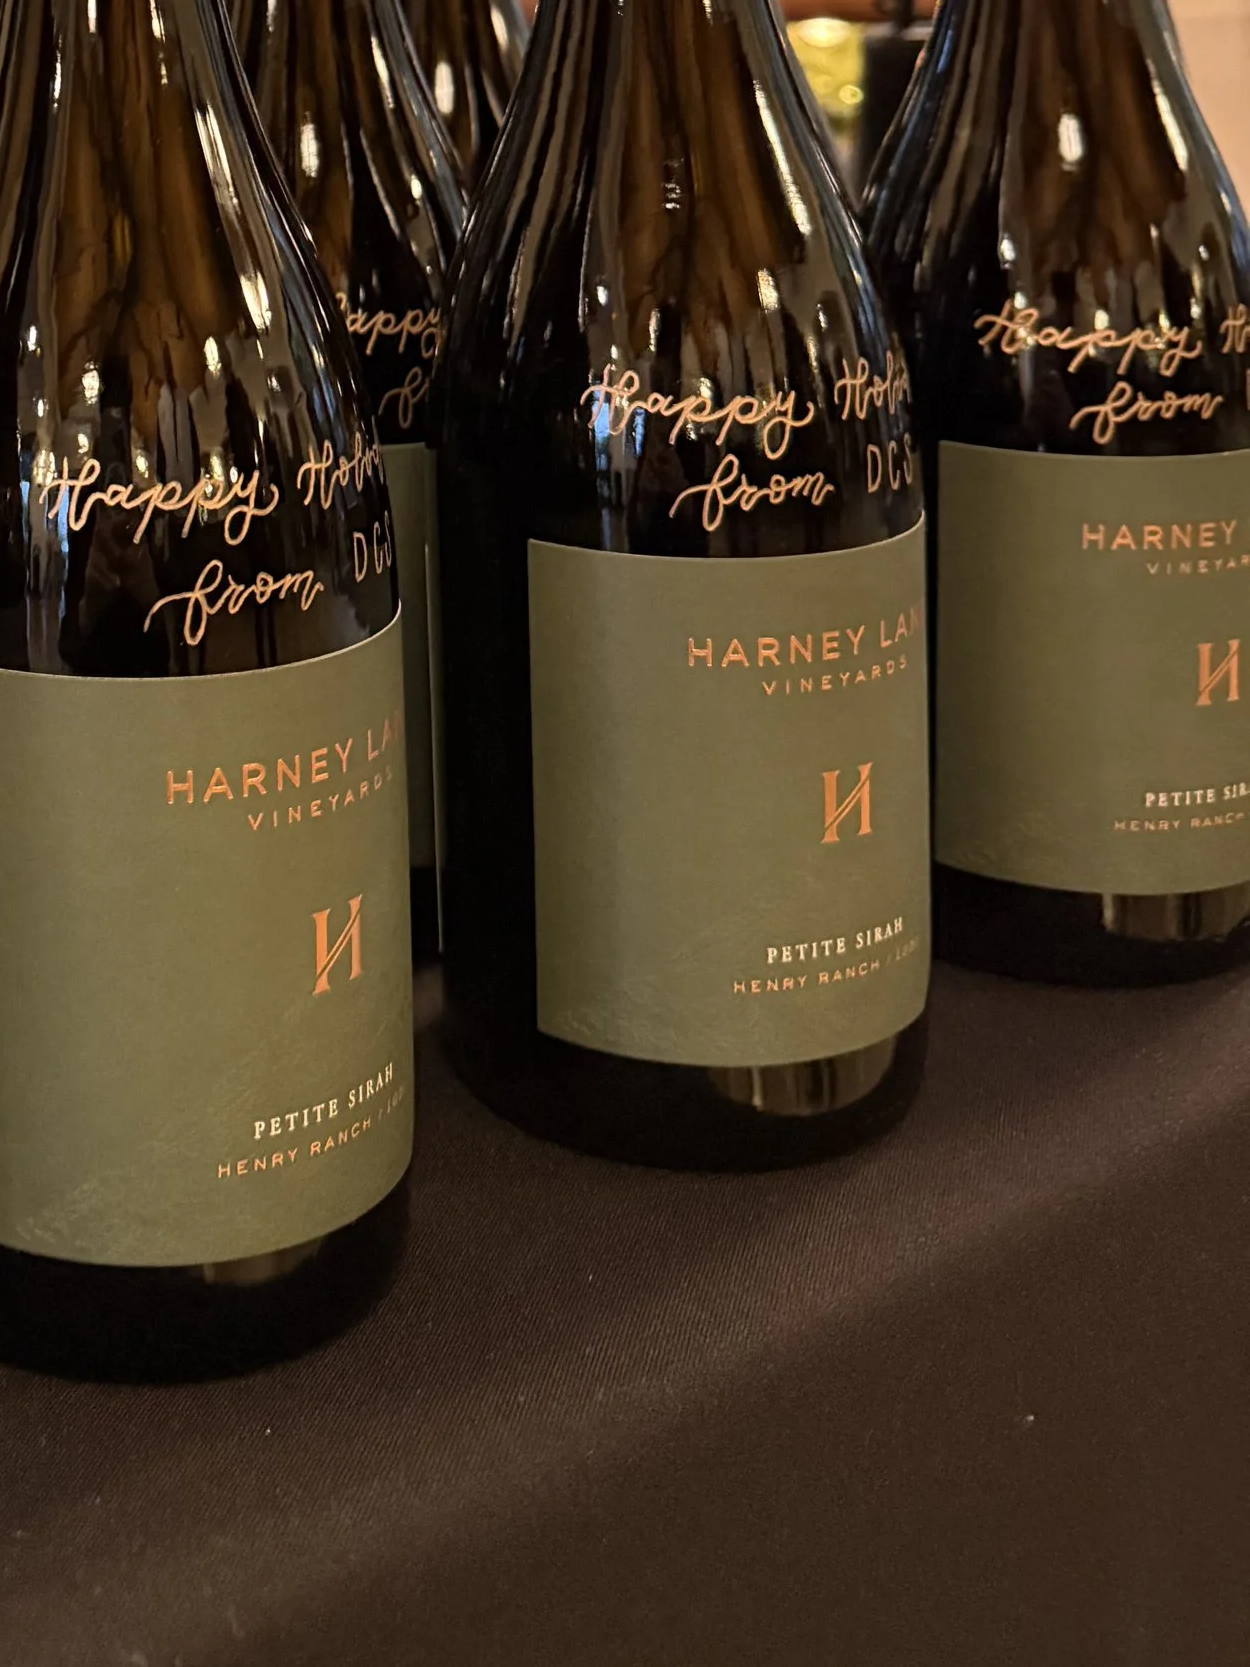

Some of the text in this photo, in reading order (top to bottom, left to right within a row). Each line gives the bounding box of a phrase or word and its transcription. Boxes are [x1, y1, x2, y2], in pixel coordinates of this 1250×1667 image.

[336, 291, 445, 359] appy
[974, 297, 1202, 377] Happy
[580, 363, 816, 460] Happy
[1068, 381, 1223, 445] from
[38, 454, 280, 546] Happy
[669, 432, 913, 532] from DCS
[1081, 519, 1237, 551] HARNEY
[1146, 553, 1250, 576] VINEYAR
[144, 509, 392, 646] from DCS
[688, 625, 866, 668] HARNEY
[762, 654, 908, 696] VINEYARDS
[166, 737, 354, 806] HARNEY
[247, 764, 393, 831] VINEYARDS
[1145, 781, 1250, 808] PETITE SIR
[766, 916, 903, 965] PETITE SIRAH
[733, 975, 808, 995] HENRY
[818, 958, 881, 987] RANCH
[253, 1061, 394, 1141] PETITE SIRAH
[216, 1148, 299, 1179] HENRY
[310, 1116, 372, 1159] RANCH
